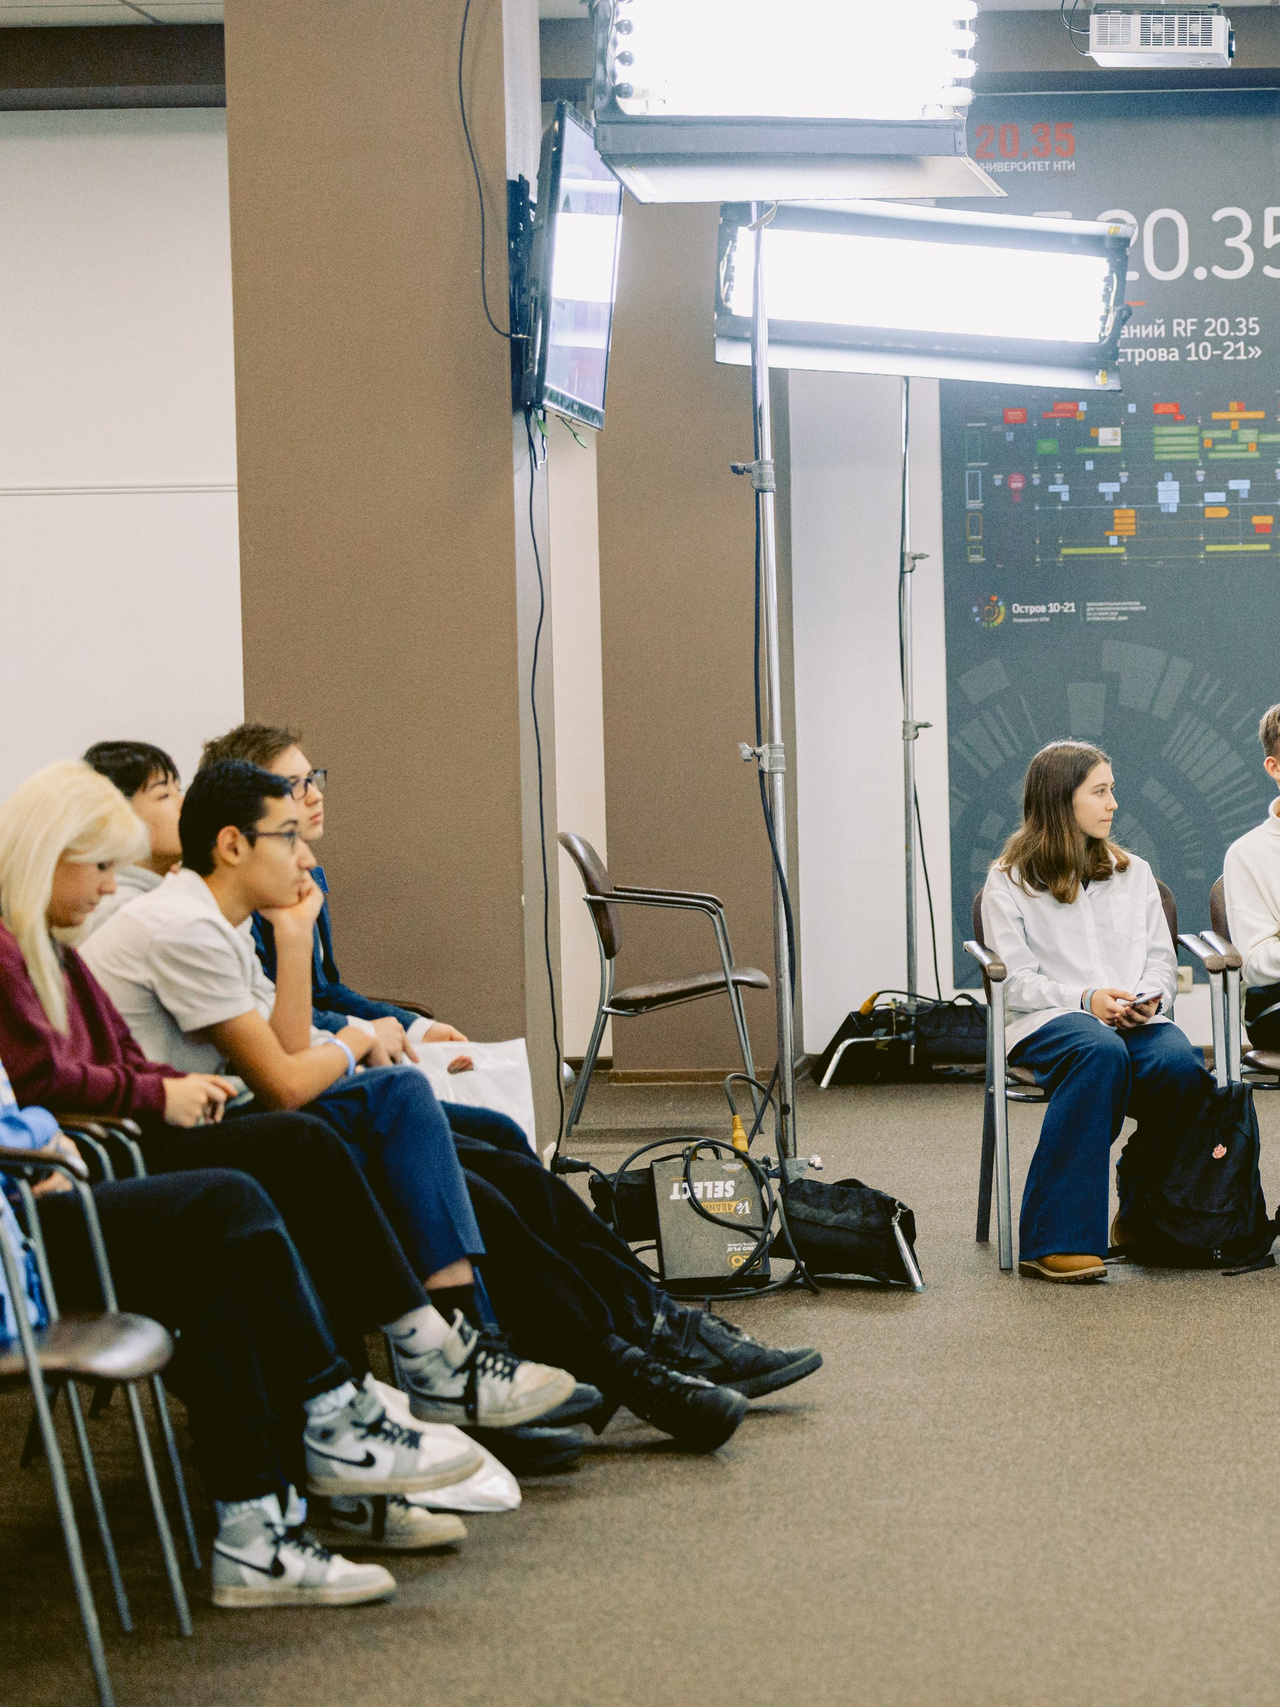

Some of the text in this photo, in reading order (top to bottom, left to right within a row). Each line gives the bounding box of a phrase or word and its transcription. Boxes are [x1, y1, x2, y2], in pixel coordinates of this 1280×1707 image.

[974, 121, 1076, 159] 20.35
[1053, 160, 1076, 171] НТИ
[1120, 317, 1260, 338] аний RF 20.35
[1118, 341, 1262, 366] строва 10-21»
[1012, 603, 1047, 615] Остров
[1047, 601, 1076, 613] 10-21
[670, 1181, 735, 1200] SELECT
